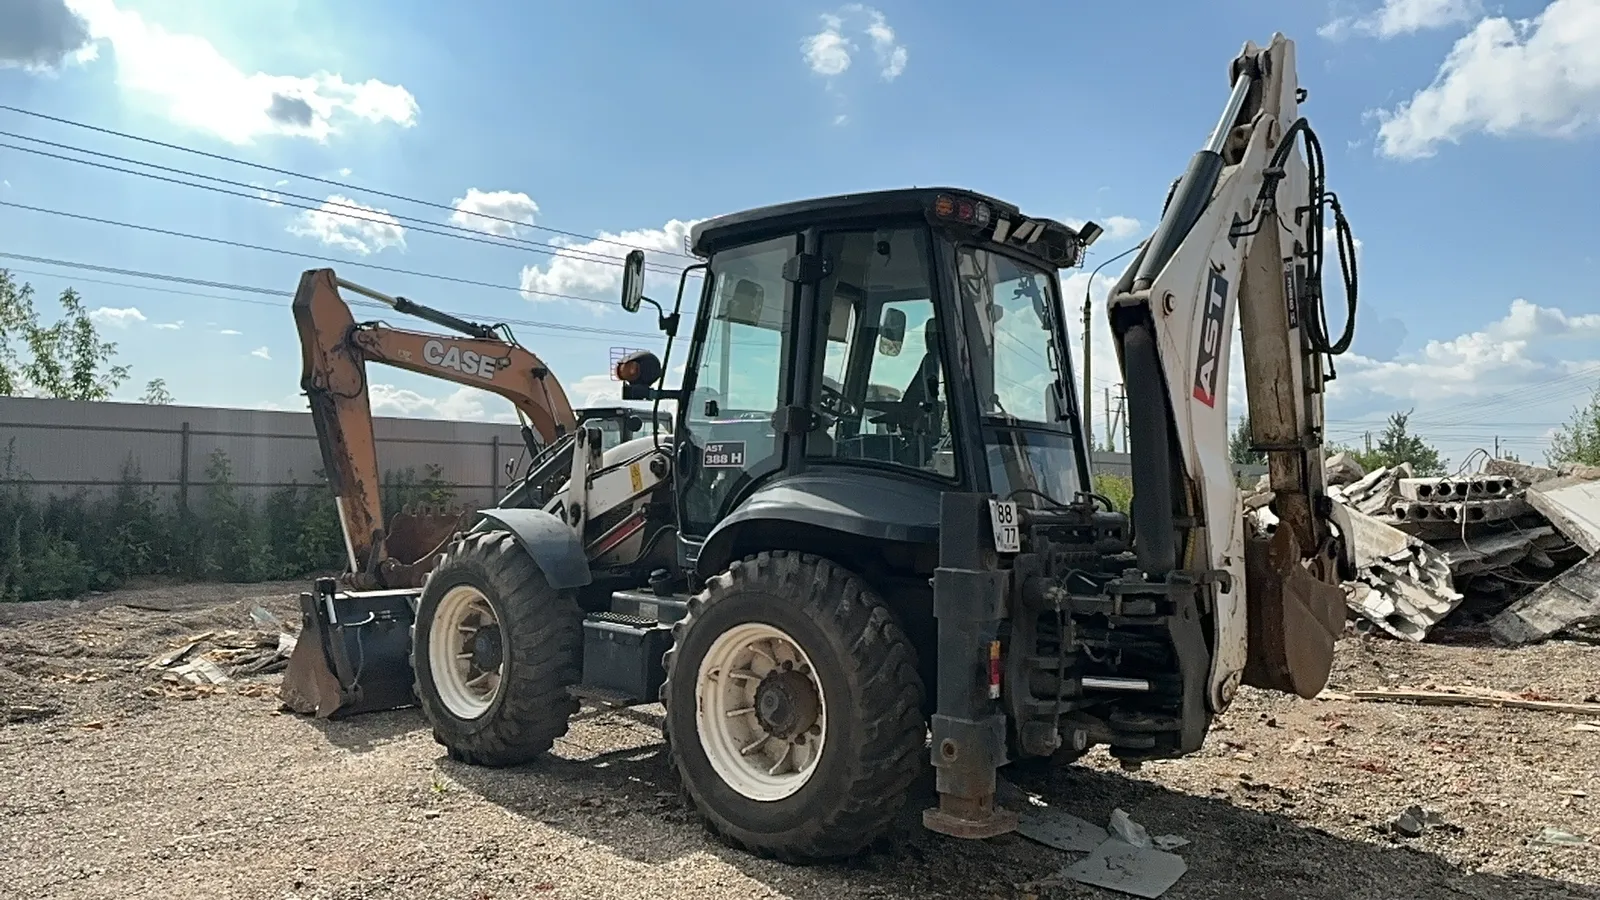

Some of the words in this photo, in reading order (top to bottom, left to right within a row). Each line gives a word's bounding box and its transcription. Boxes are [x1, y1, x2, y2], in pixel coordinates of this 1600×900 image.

[1200, 278, 1222, 400] AST
[423, 340, 497, 379] CASE
[705, 444, 723, 452] AST
[705, 454, 728, 464] 388
[731, 452, 742, 463] H
[997, 504, 1012, 524] 88
[1004, 527, 1016, 543] 77
